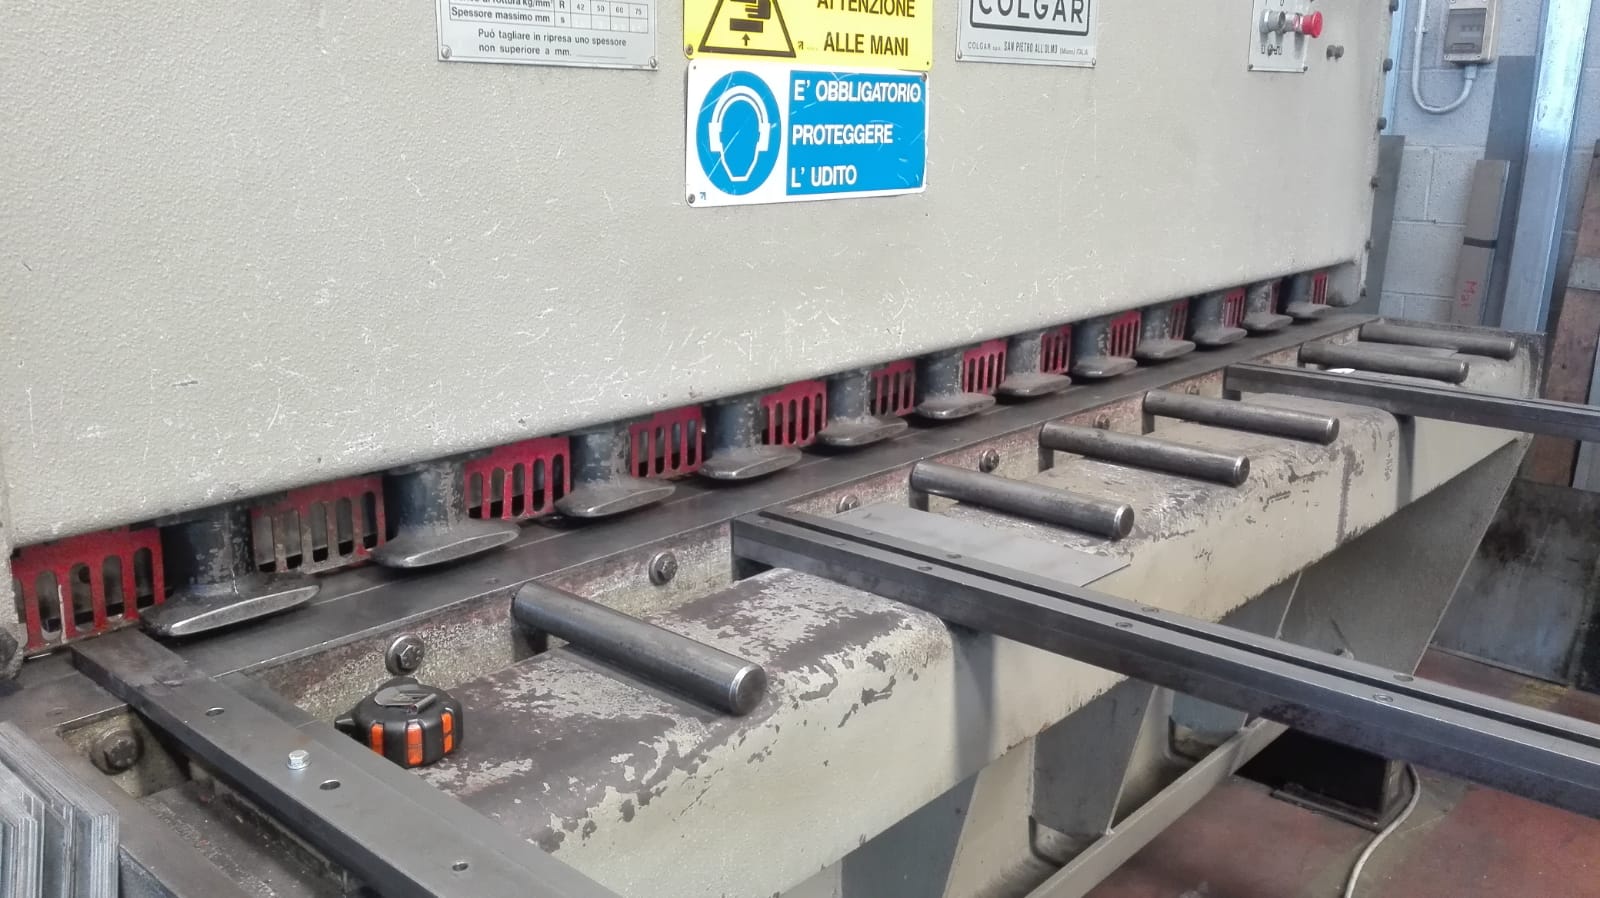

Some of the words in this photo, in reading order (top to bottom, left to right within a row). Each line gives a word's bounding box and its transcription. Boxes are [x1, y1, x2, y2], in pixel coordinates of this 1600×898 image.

[559, 0, 565, 9] R
[576, 3, 585, 11] 42
[596, 5, 605, 13] 50
[978, 0, 1083, 24] COLGAR
[451, 6, 493, 18] Spessore
[495, 11, 533, 21] massimo
[535, 14, 551, 22] mm
[499, 29, 531, 41] tagliare
[533, 32, 541, 41] in
[543, 33, 572, 44] ripresa
[574, 36, 590, 45] uno
[591, 37, 627, 47] spessore
[823, 31, 865, 54] ALLE
[870, 34, 909, 57] MANI
[479, 44, 496, 53] non
[499, 45, 541, 55] superiore
[554, 48, 572, 57] mm.
[793, 79, 811, 101] E'
[815, 79, 921, 103] OBBLIGATORIO
[791, 123, 894, 146] PROTEGGERE
[790, 166, 806, 188] L'
[810, 164, 858, 187] UDITO
